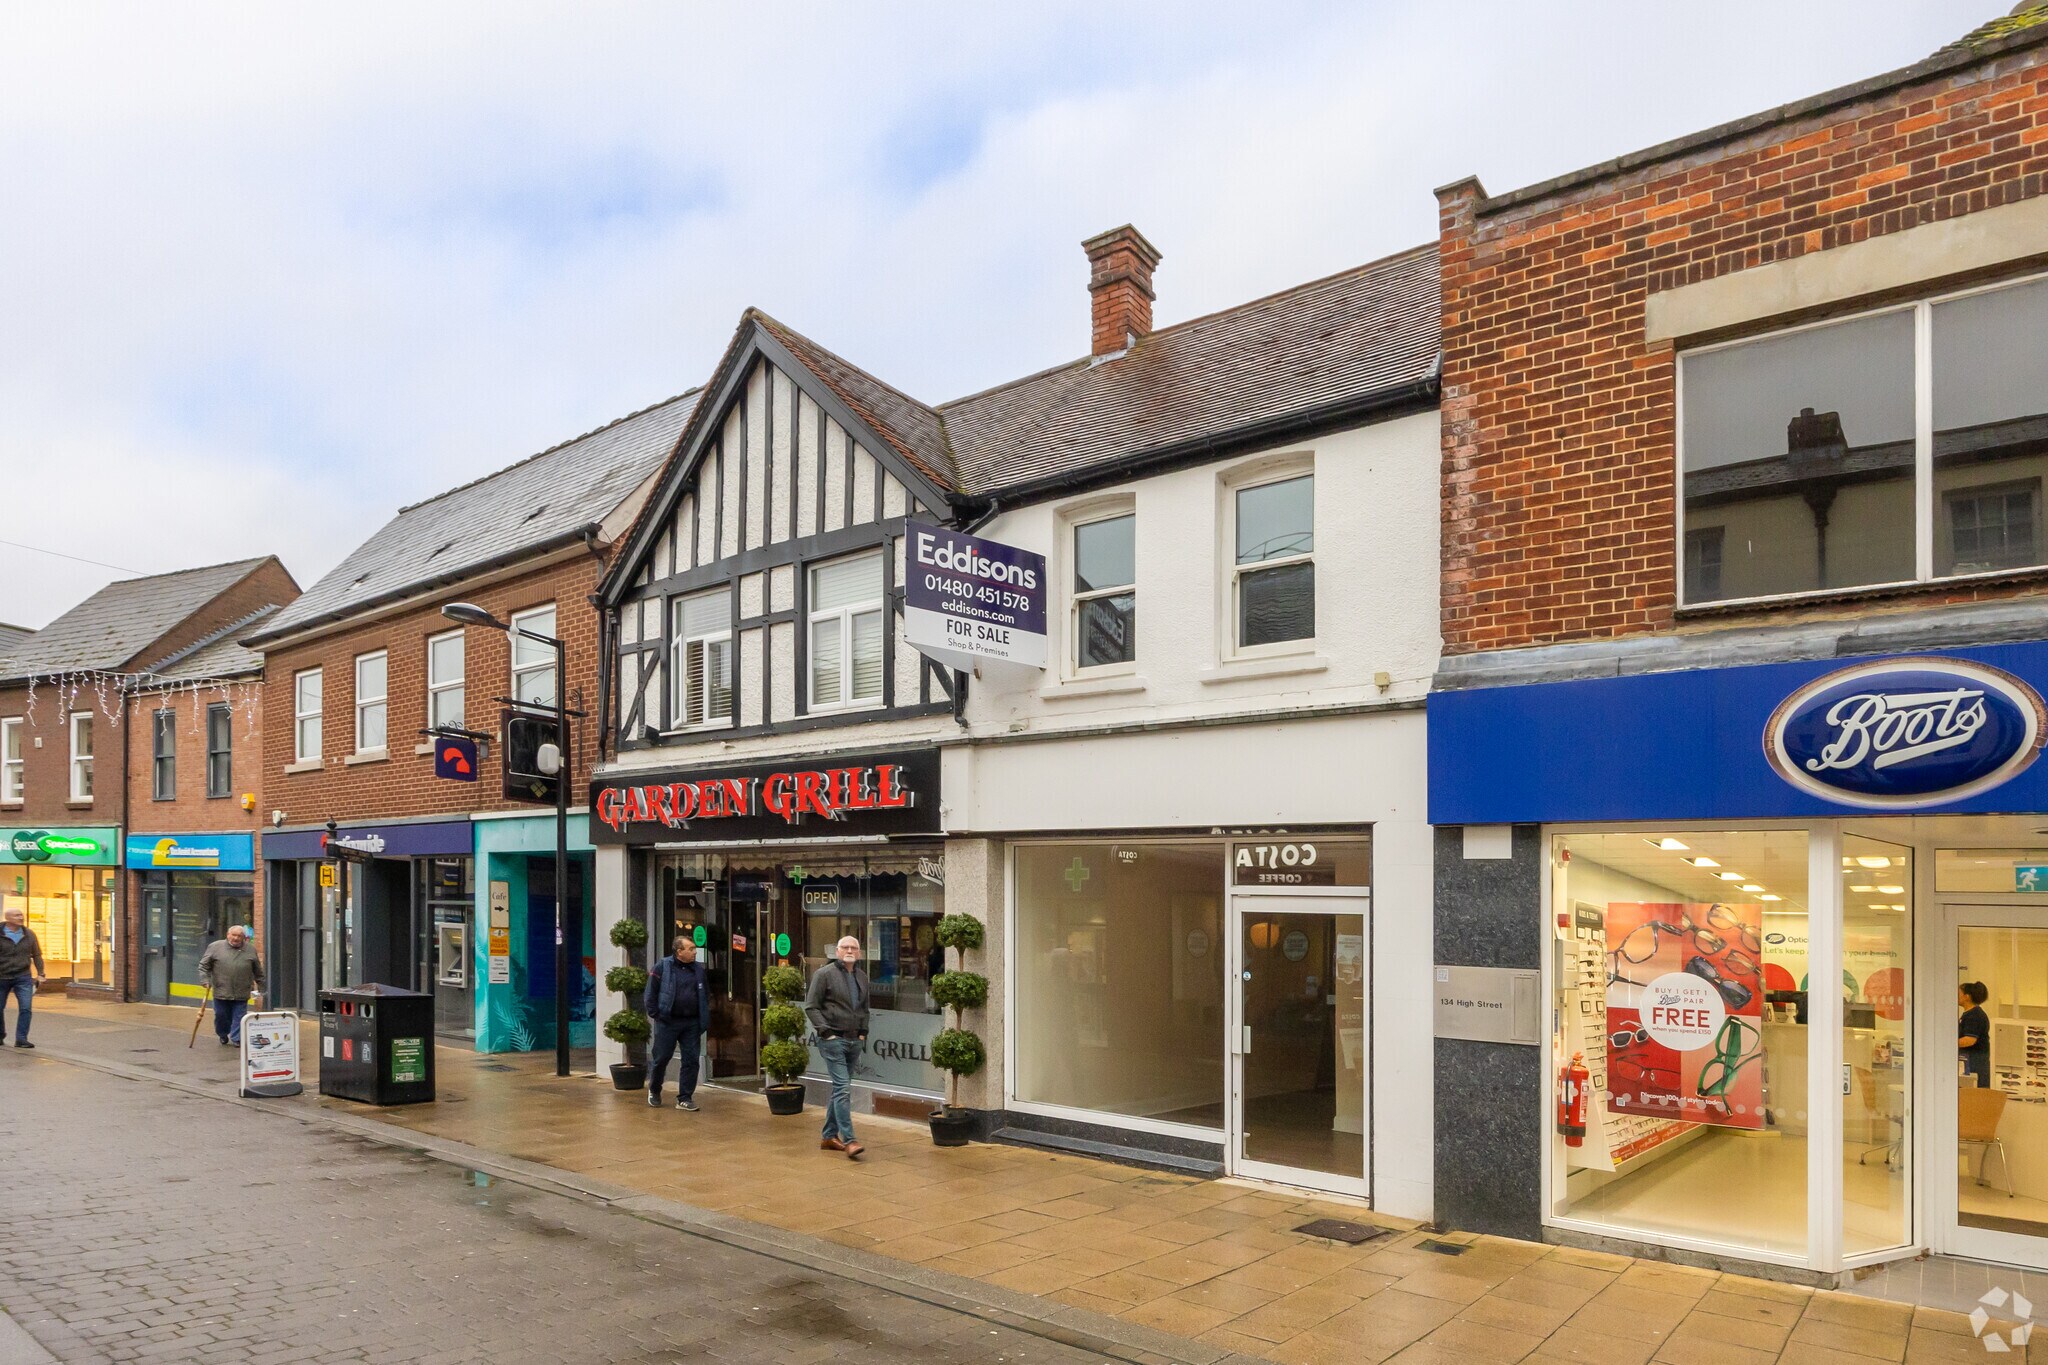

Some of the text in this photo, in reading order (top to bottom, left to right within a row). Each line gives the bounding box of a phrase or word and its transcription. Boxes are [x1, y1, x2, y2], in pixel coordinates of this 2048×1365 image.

[917, 531, 1036, 590] Eddisons
[925, 574, 973, 599] 01480
[941, 598, 1015, 625] eddisons.com
[946, 618, 1010, 645] FOR SALE
[947, 637, 1009, 658] Shop & Premises
[1806, 687, 1987, 772] Boots
[596, 764, 914, 834] GARDEN GRILL
[45, 839, 96, 850] Specsavers
[805, 891, 837, 905] OPEN
[1764, 946, 1784, 954] Let's
[1785, 947, 1805, 955] keep
[1657, 994, 1705, 1006] Boots PAIR
[1682, 988, 1701, 996] GET
[1440, 998, 1503, 1009] 134 High Street
[1653, 1007, 1710, 1028] FREE
[873, 1039, 932, 1062] GRILL
